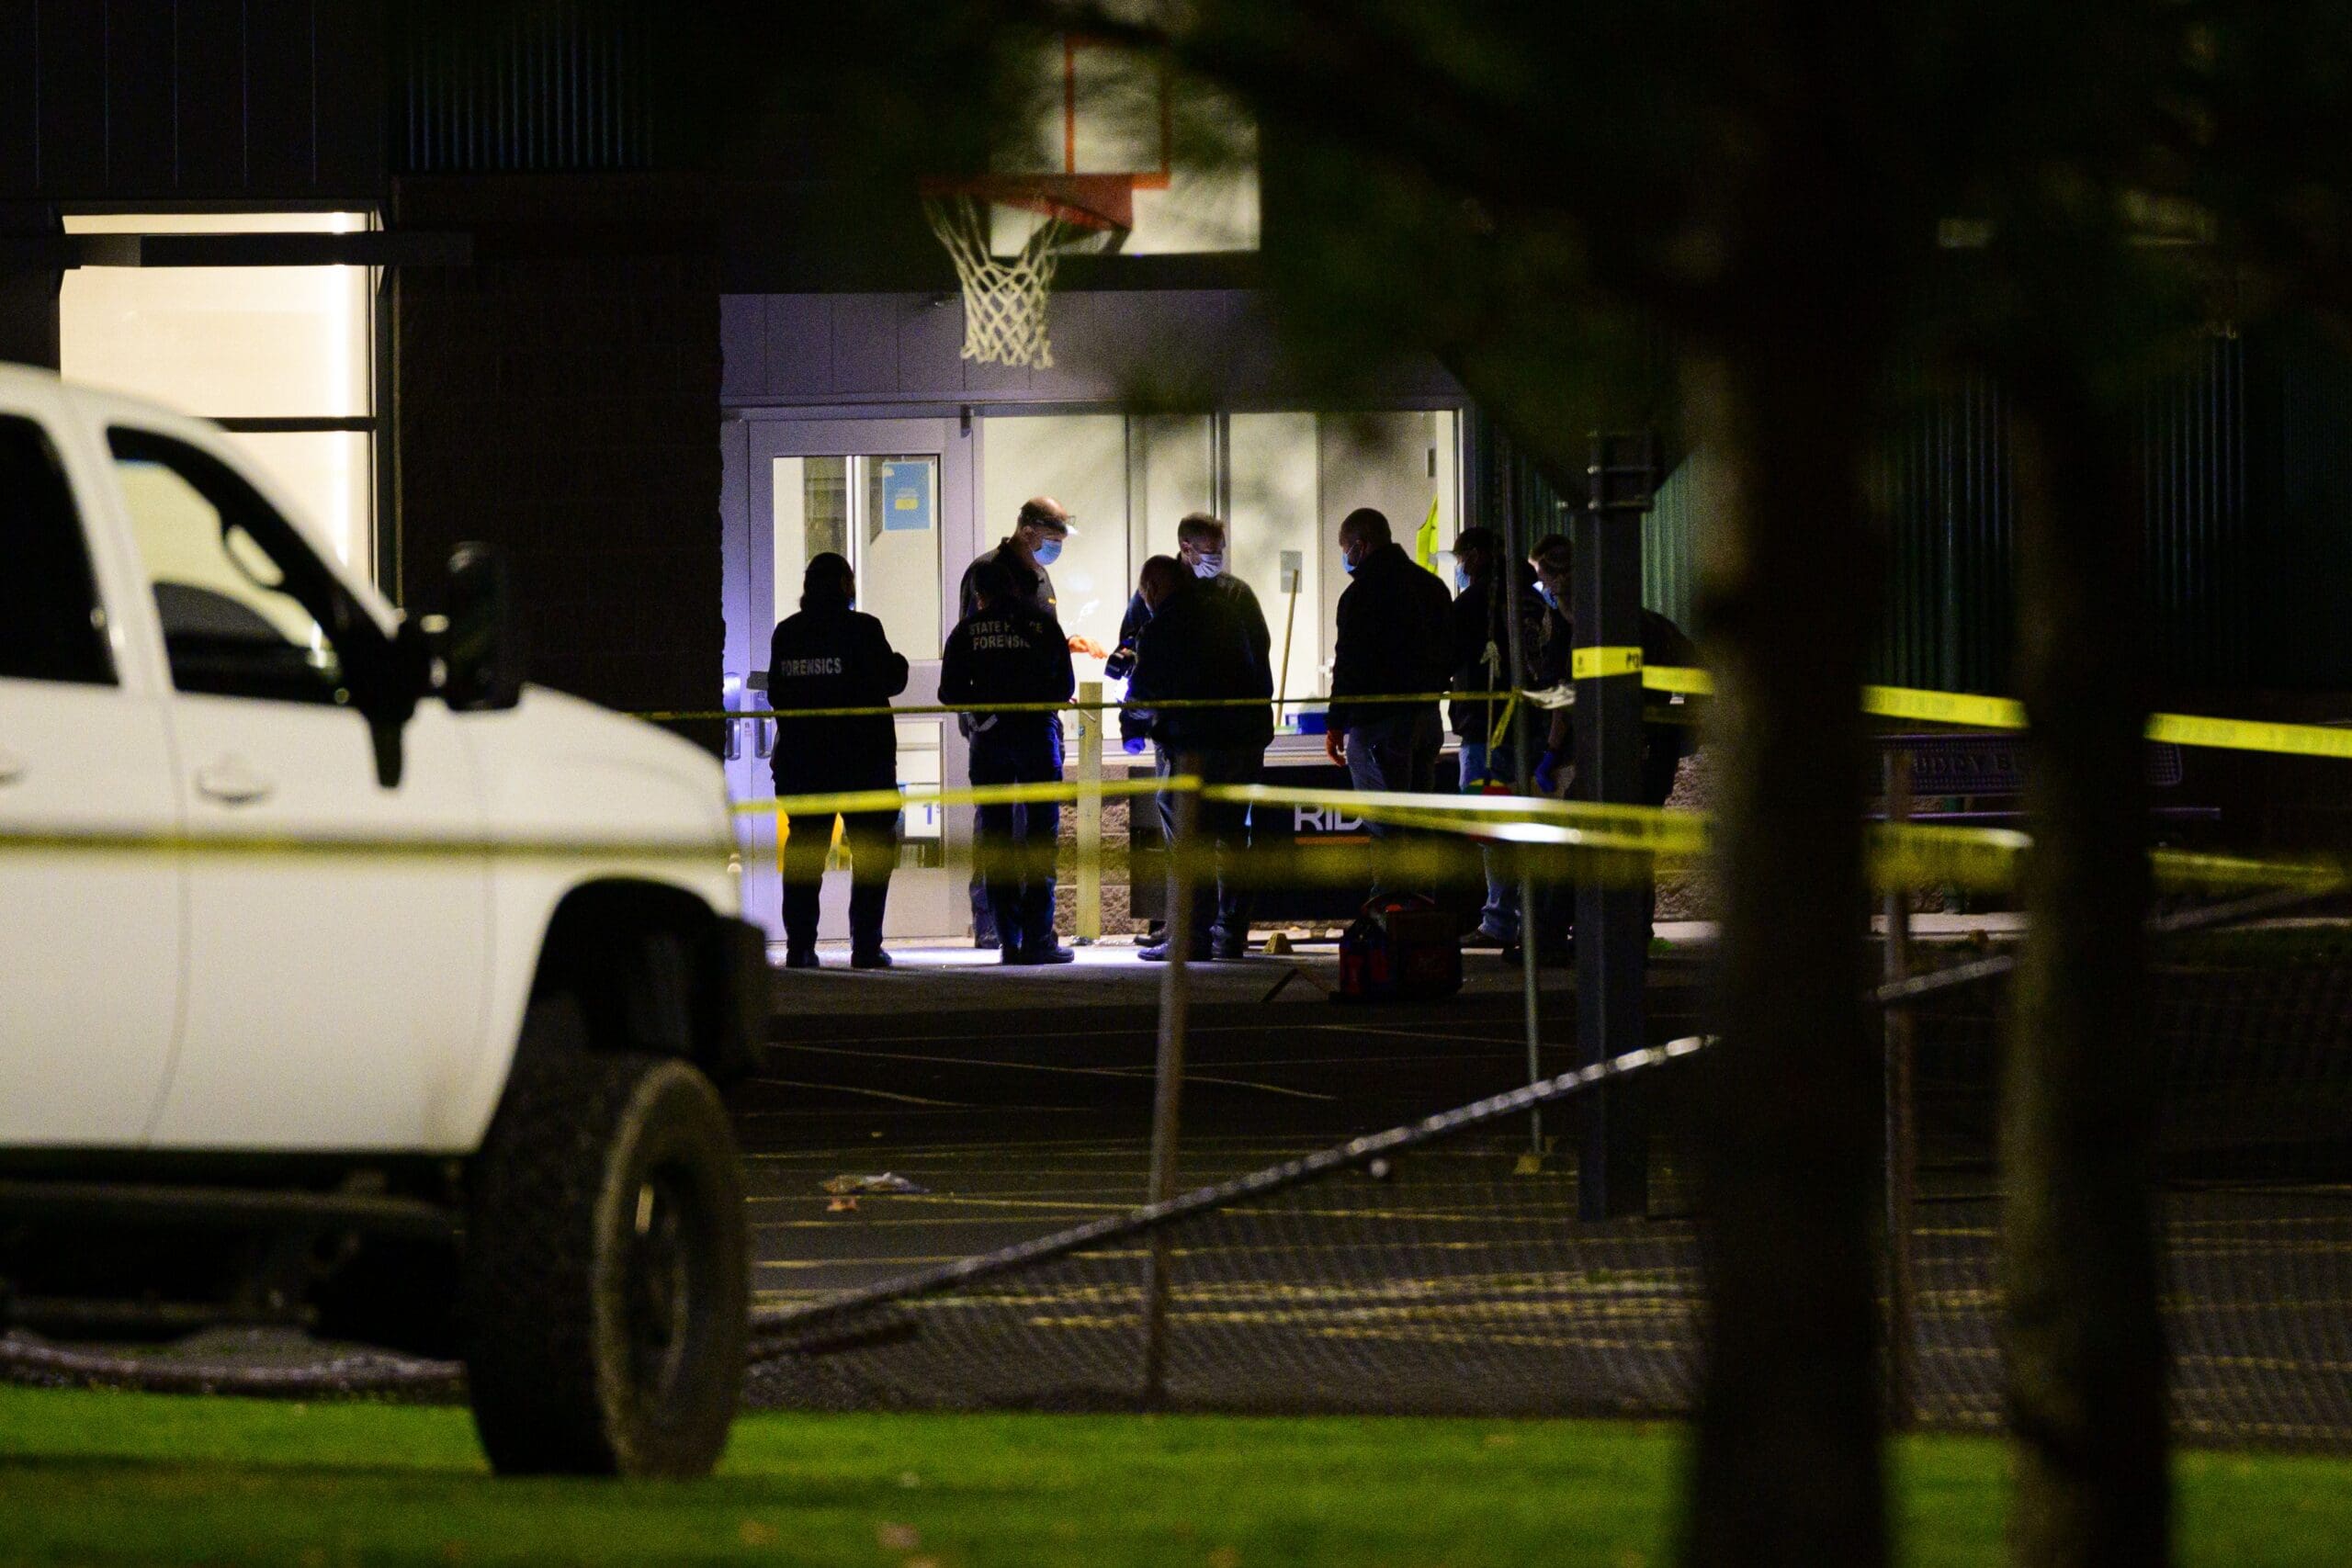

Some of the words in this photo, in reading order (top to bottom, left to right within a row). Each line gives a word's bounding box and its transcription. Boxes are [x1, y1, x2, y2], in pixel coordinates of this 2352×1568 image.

[969, 620, 1001, 636] STATE
[972, 634, 1032, 651] FORENSI
[779, 657, 842, 677] FORENSICS
